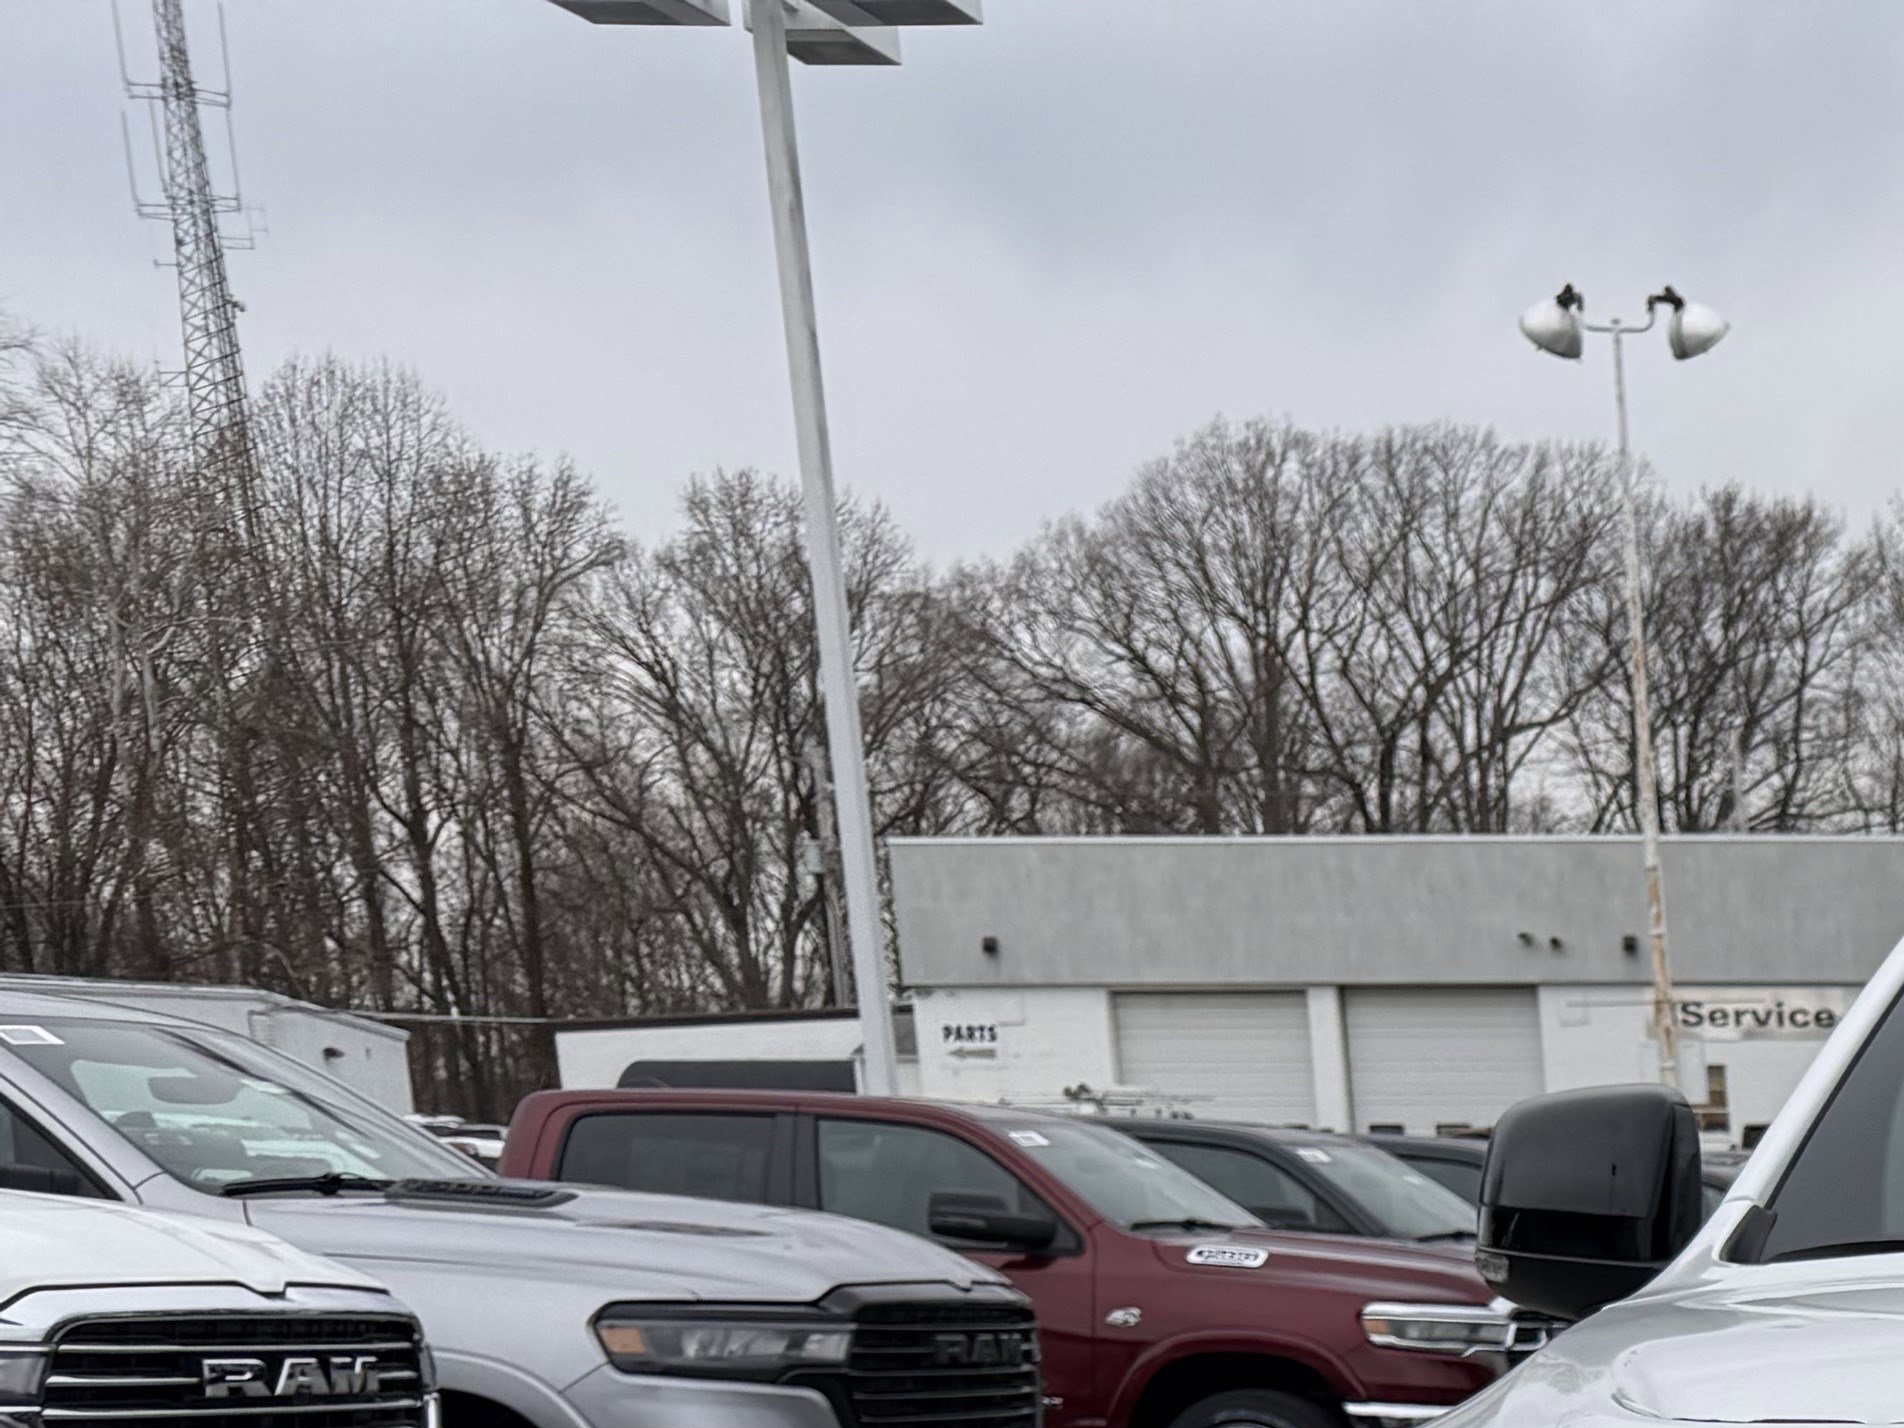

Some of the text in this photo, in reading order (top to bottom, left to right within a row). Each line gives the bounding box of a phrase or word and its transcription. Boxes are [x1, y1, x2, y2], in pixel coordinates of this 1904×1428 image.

[1680, 1001, 1836, 1028] Service
[943, 1024, 998, 1042] PARTS
[202, 1356, 379, 1398] RAM
